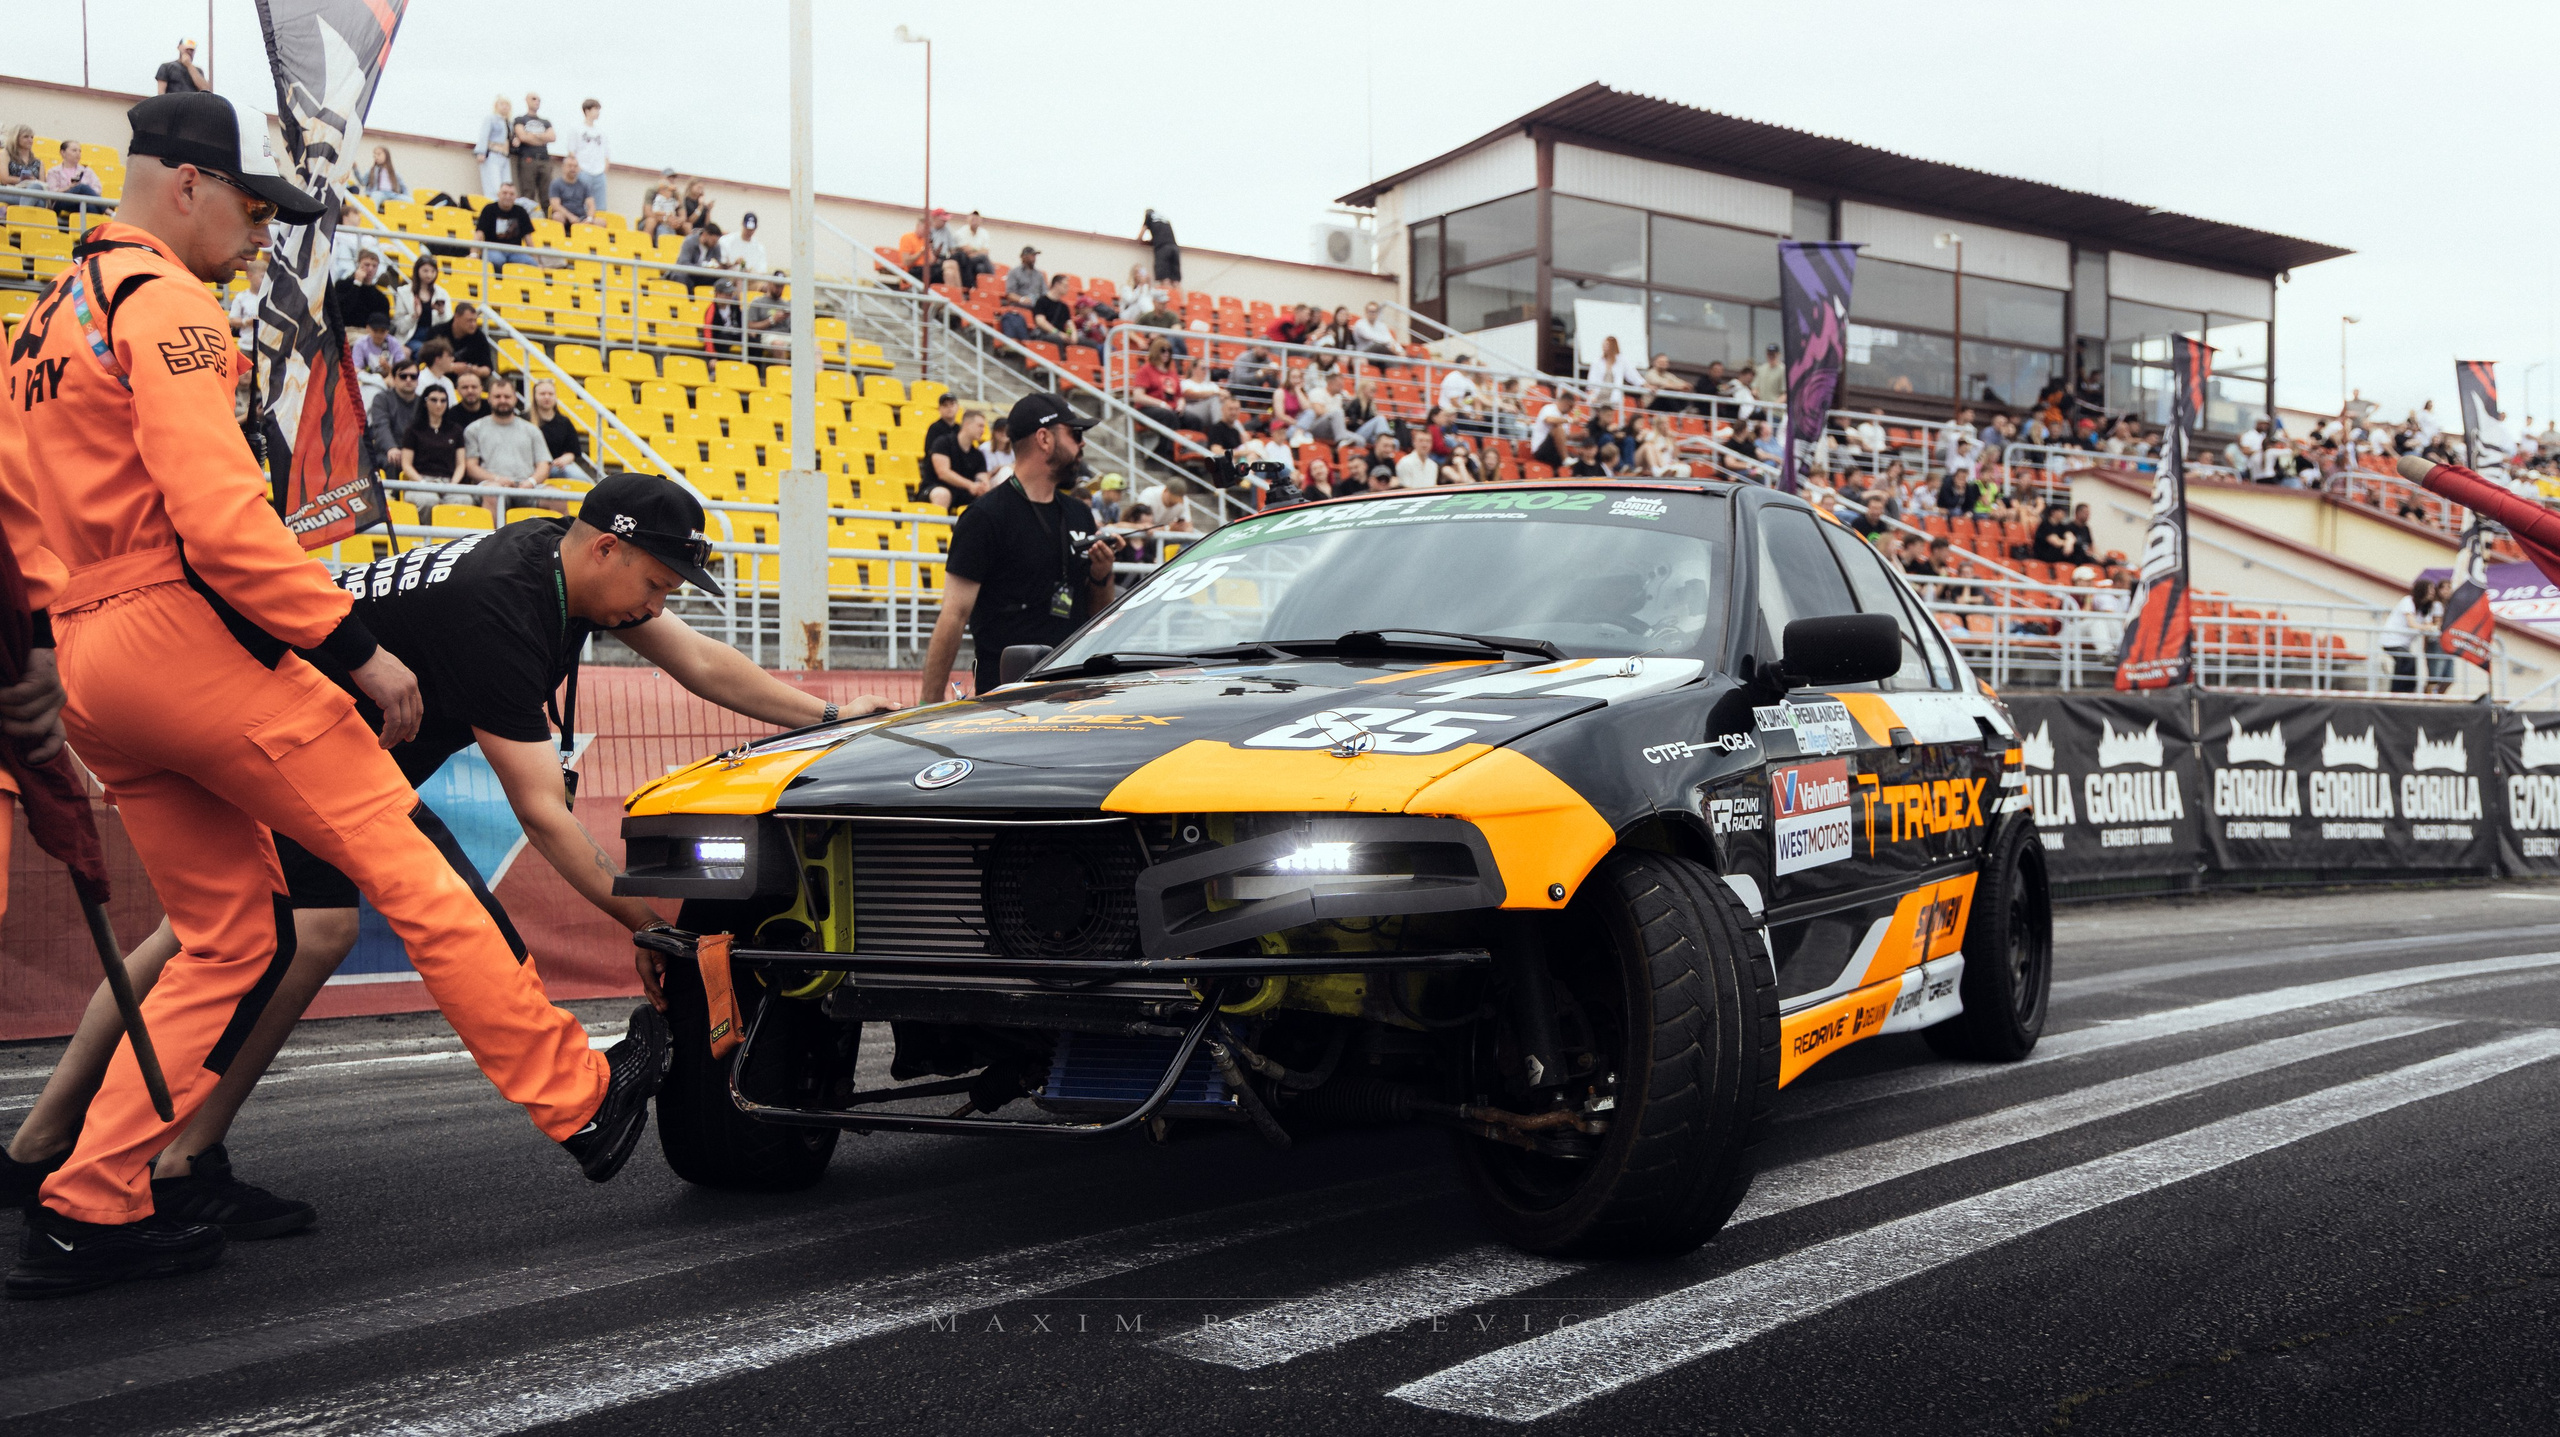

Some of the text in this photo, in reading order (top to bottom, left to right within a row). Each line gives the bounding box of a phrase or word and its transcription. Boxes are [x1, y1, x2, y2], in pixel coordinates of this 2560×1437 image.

[1264, 492, 1606, 534] DRIFT PRO2
[1611, 501, 1668, 514] GORILLA
[1118, 554, 1248, 611] 85
[923, 714, 1185, 729] TRADEX
[1243, 707, 1517, 753] 85
[1733, 797, 1760, 814] GONKI
[1798, 777, 1850, 811] Valvoline
[1882, 777, 1987, 843] TRADEX
[2085, 770, 2185, 824] GORILLA
[2214, 768, 2302, 817] GORILLA
[2309, 771, 2396, 819] GORILLA
[2401, 774, 2484, 820] GORILLA
[1731, 815, 1763, 832] RACING
[1778, 821, 1850, 861] WESTMOTORS
[1793, 1017, 1845, 1058] REDRIVE
